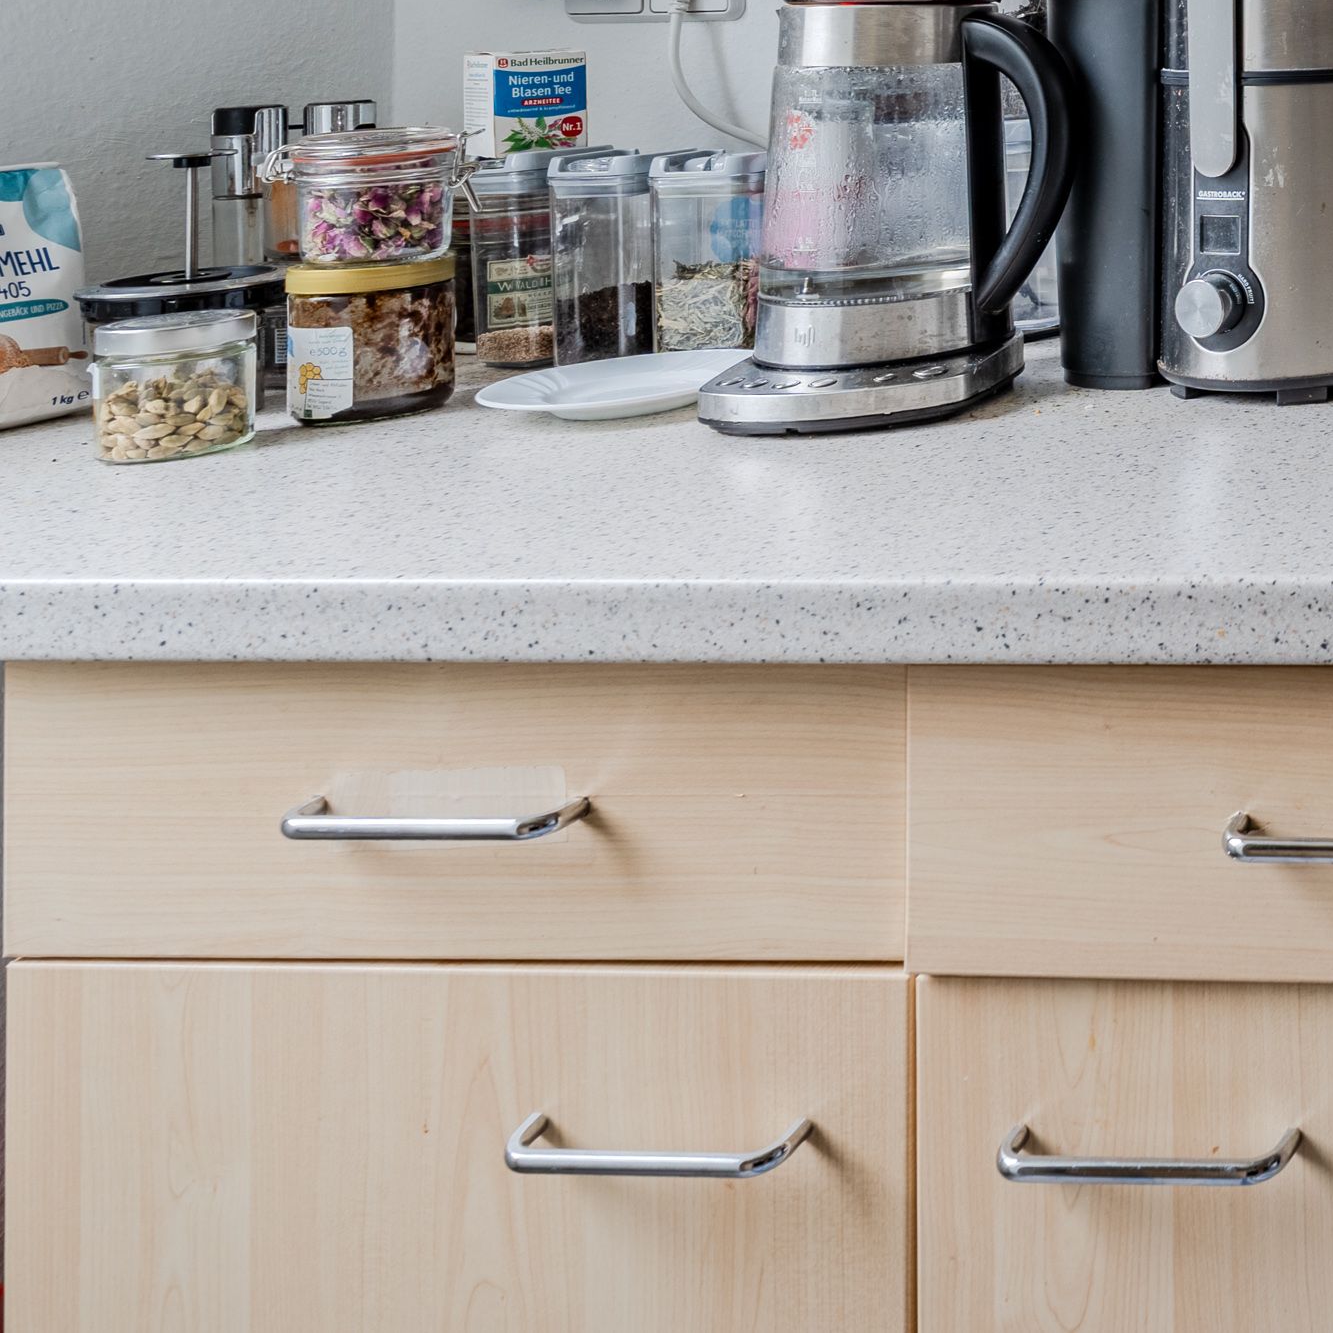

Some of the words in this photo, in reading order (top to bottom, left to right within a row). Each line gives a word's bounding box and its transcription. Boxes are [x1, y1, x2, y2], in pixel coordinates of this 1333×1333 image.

[510, 57, 528, 67] Bad
[529, 56, 584, 66] Heilbrunner
[553, 71, 574, 83] und
[512, 86, 551, 98] Blasen
[553, 84, 572, 96] Tee
[523, 98, 561, 106] ARZNEITEE
[30, 304, 45, 314] UND
[46, 302, 64, 311] PIZZA
[60, 394, 74, 407] kg
